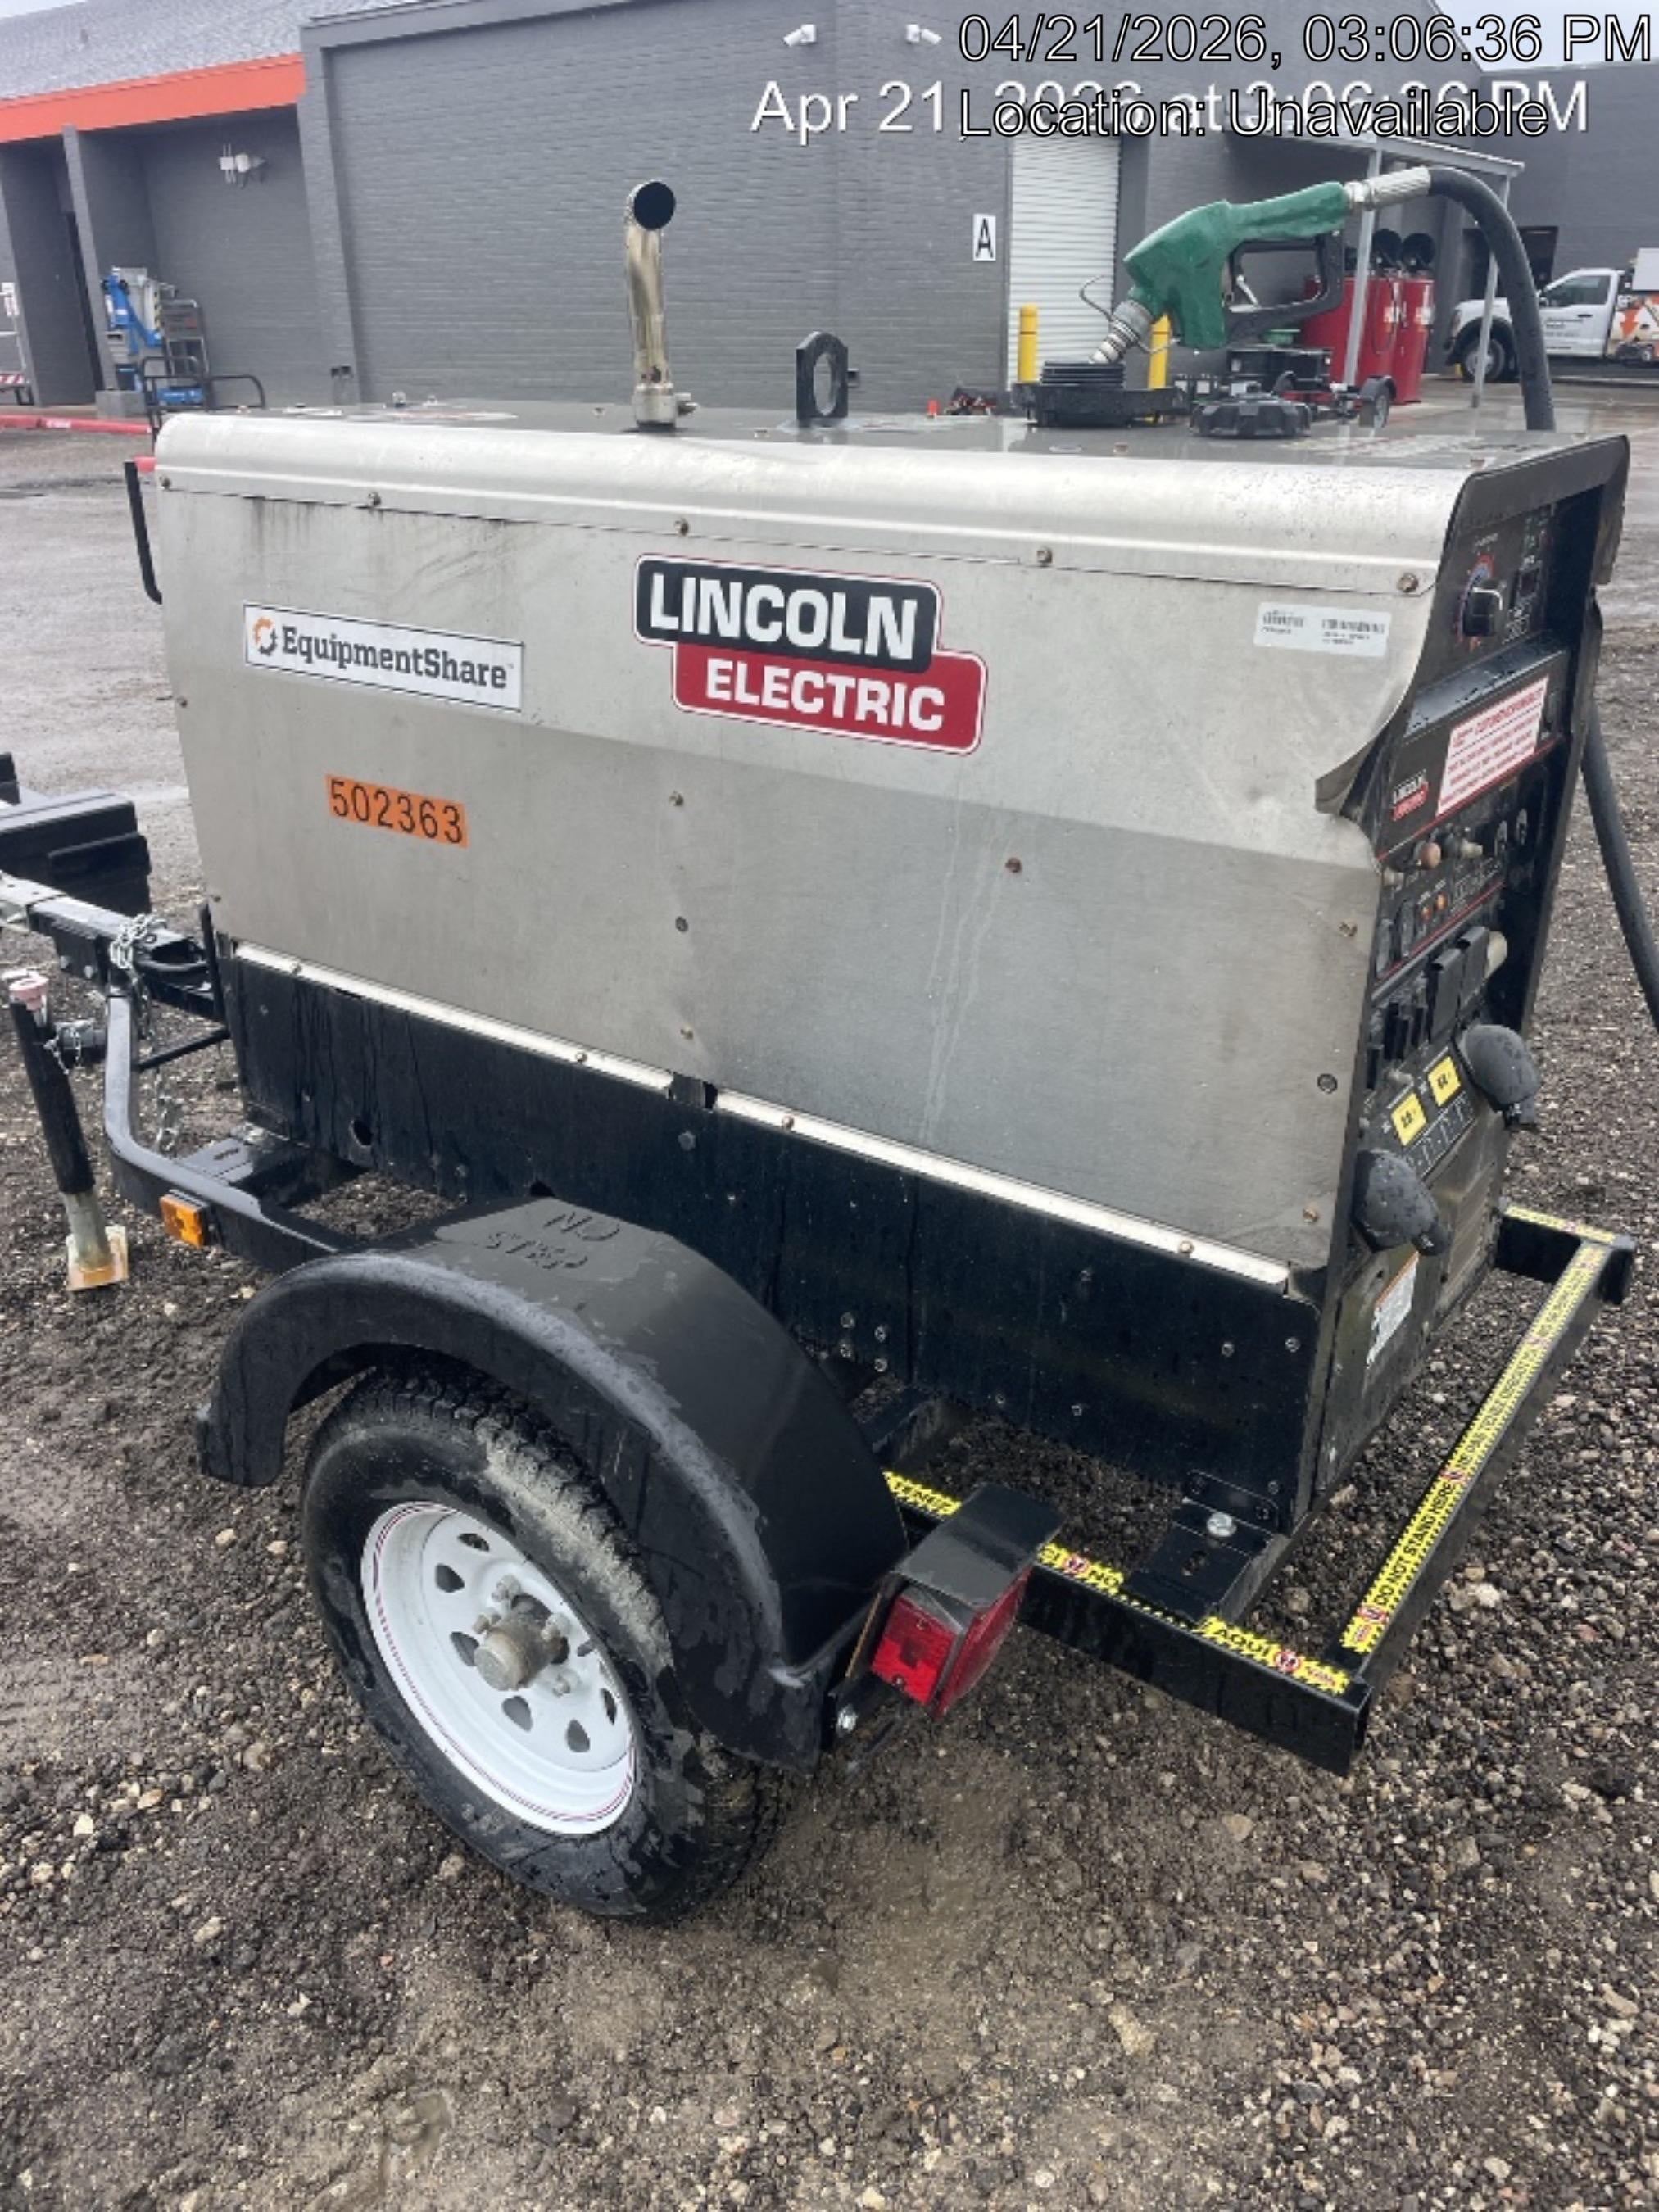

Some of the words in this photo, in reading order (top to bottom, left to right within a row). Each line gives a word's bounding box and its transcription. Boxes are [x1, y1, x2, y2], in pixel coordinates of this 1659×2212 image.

[975, 218, 994, 258] A
[650, 573, 918, 660] LINCOLN
[282, 625, 507, 690] EquipmentShare
[705, 658, 945, 732] ELECTRIC
[330, 779, 464, 845] 502363
[1374, 1585, 1394, 1607] DO
[1391, 1557, 1411, 1586] NOT
[1403, 1515, 1436, 1556] STAND
[1434, 1483, 1454, 1514] HERE
